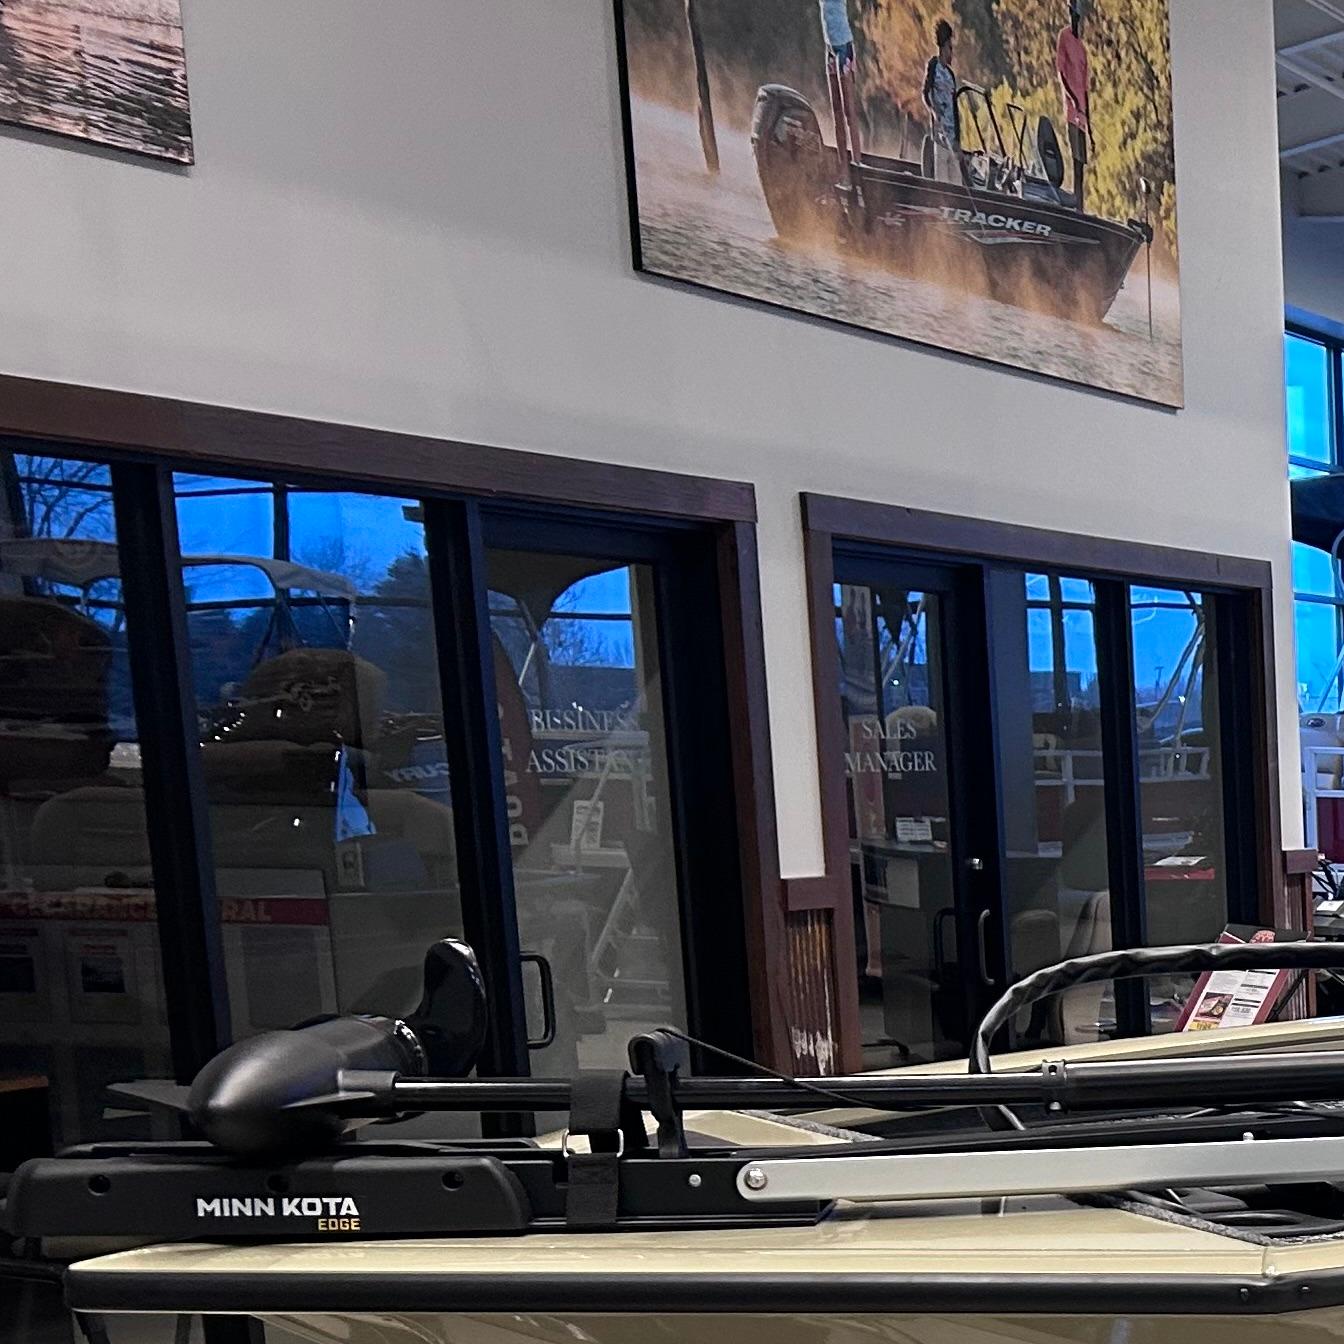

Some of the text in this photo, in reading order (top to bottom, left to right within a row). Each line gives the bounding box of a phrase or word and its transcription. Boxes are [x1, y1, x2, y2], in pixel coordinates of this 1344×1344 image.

[939, 206, 1052, 237] TRACKER
[862, 719, 917, 739] SALES
[844, 751, 937, 773] MANAGER
[196, 1197, 360, 1217] MINN KOTA
[317, 1217, 362, 1232] EDGE
